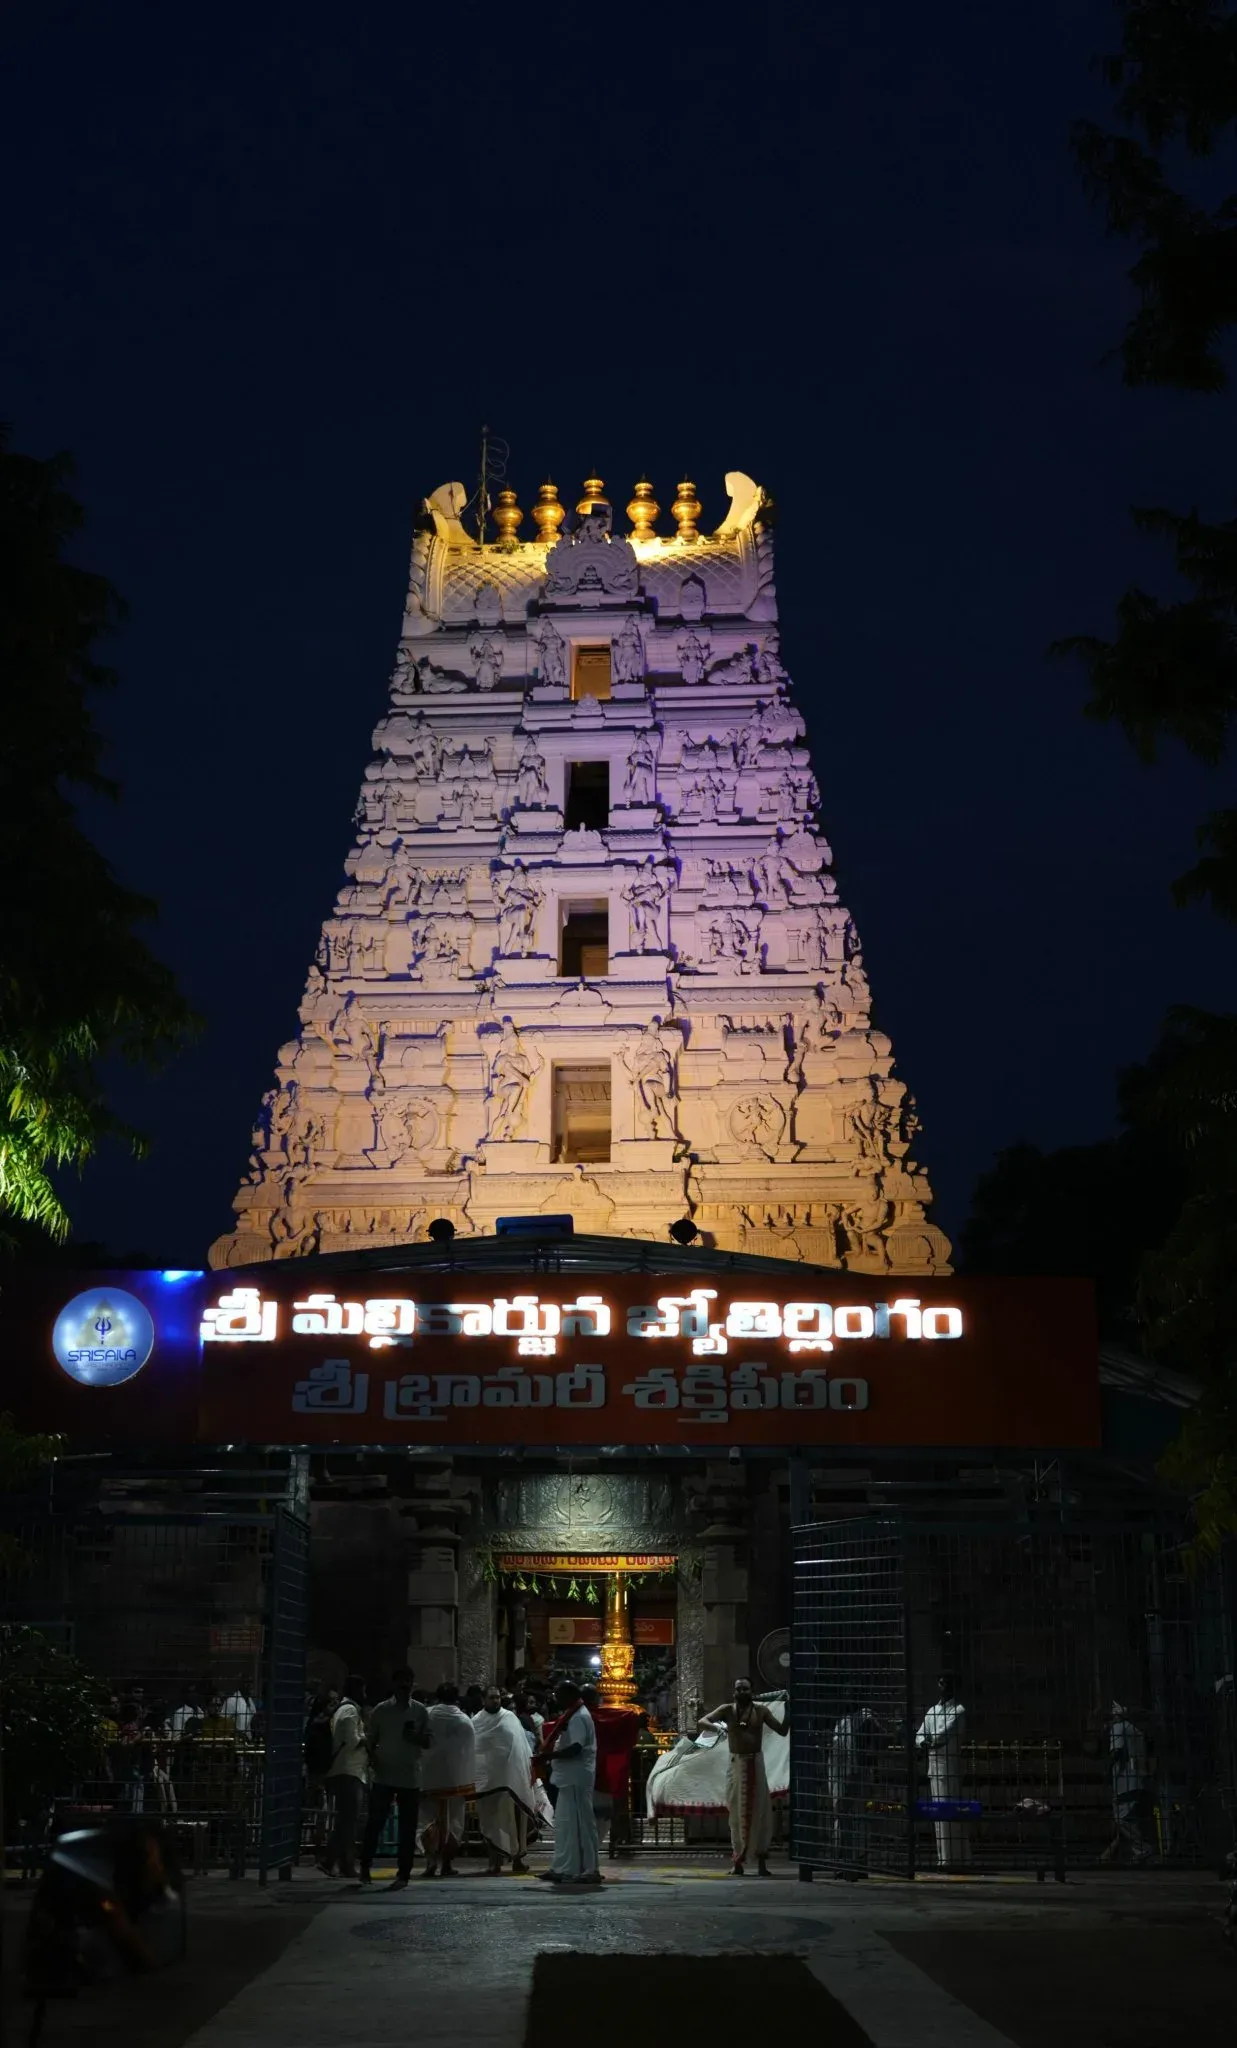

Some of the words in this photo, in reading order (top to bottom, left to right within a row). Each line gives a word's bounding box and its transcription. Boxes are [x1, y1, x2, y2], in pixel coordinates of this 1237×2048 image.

[201, 1288, 277, 1341] శ్రీ
[68, 1349, 137, 1362] SRISAILA
[292, 1359, 369, 1414] శ్రీ
